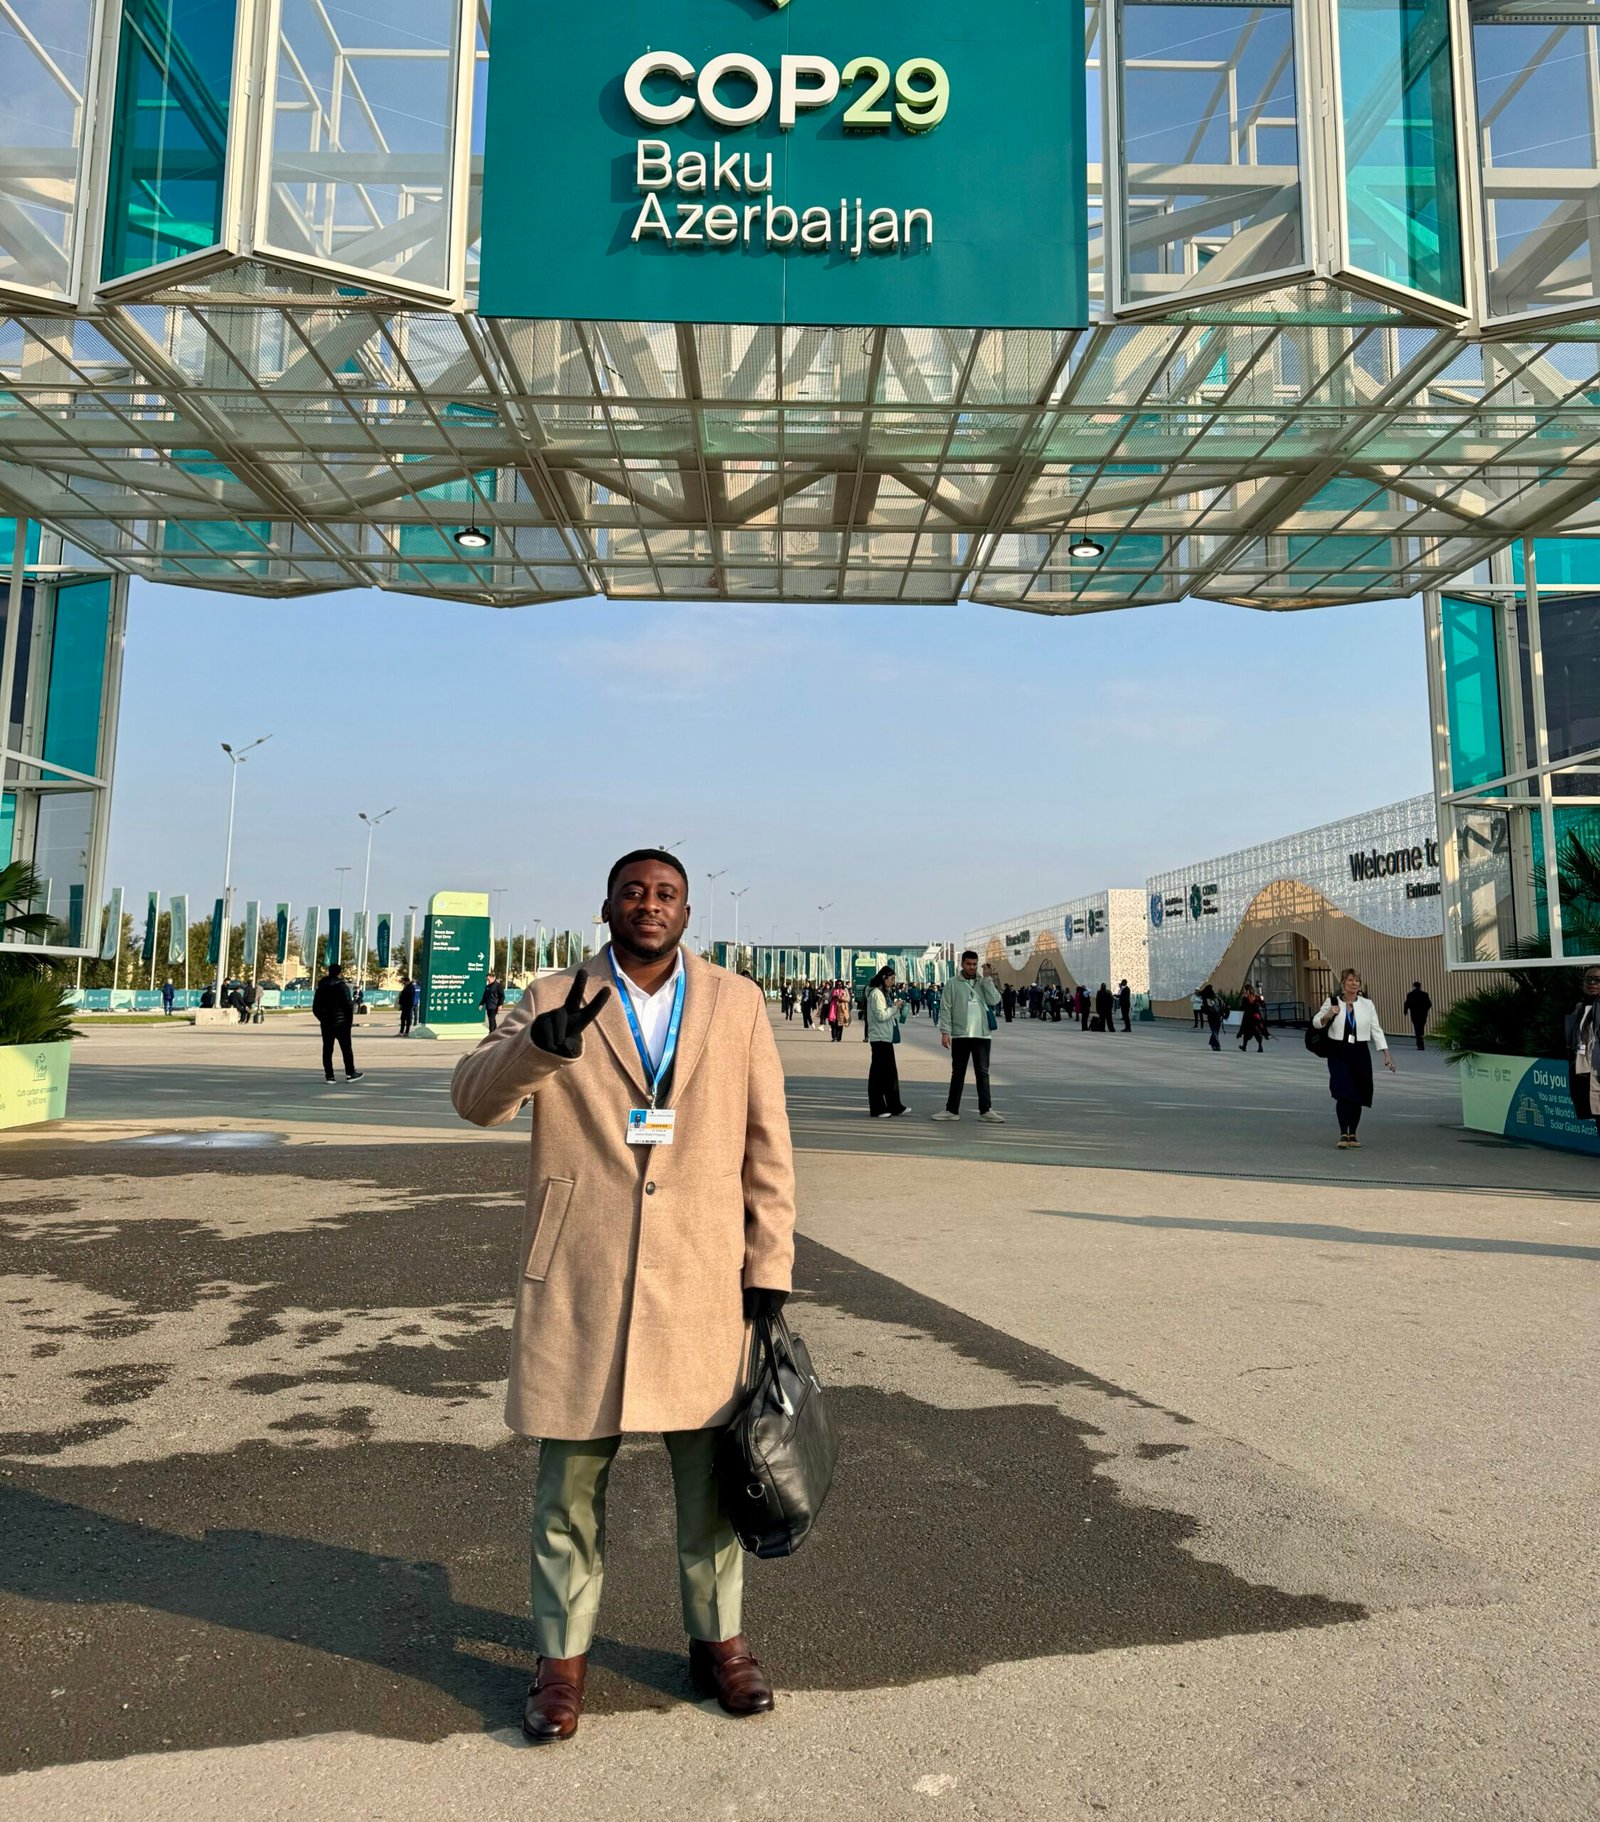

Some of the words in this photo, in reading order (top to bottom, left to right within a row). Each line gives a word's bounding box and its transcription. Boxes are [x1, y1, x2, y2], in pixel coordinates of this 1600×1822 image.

[624, 50, 950, 130] COP29
[636, 139, 773, 192] Baku
[631, 192, 933, 257] Azerbaijan
[1349, 846, 1422, 882] Welcome
[1406, 881, 1441, 899] Entranc
[1533, 1069, 1549, 1086] Did
[1550, 1074, 1567, 1089] you
[1538, 1091, 1549, 1101] You
[1548, 1094, 1558, 1103] are
[1544, 1105, 1554, 1116] The
[1550, 1120, 1564, 1130] Solar
[1564, 1121, 1580, 1133] Glass
[1581, 1124, 1598, 1136] Arch?
